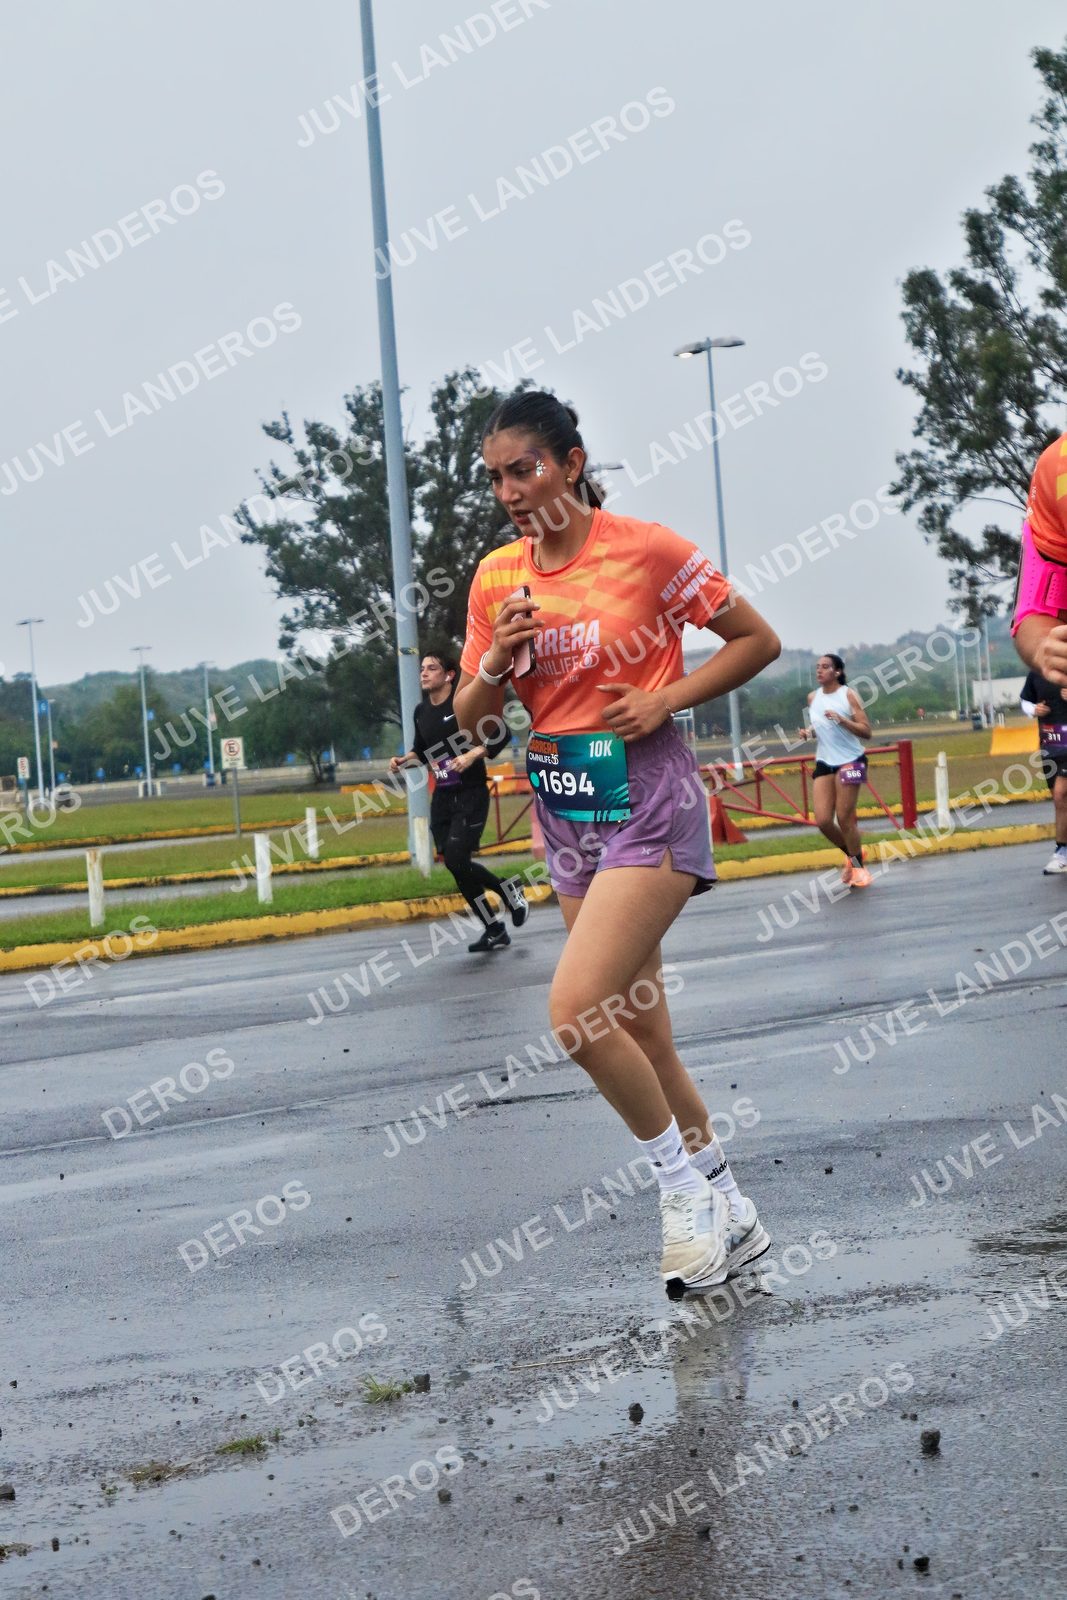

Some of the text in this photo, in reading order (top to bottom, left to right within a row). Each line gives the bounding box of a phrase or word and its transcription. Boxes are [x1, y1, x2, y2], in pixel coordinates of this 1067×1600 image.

[534, 619, 600, 657] RRERA
[589, 740, 612, 758] 10K
[538, 770, 594, 796] 1694
